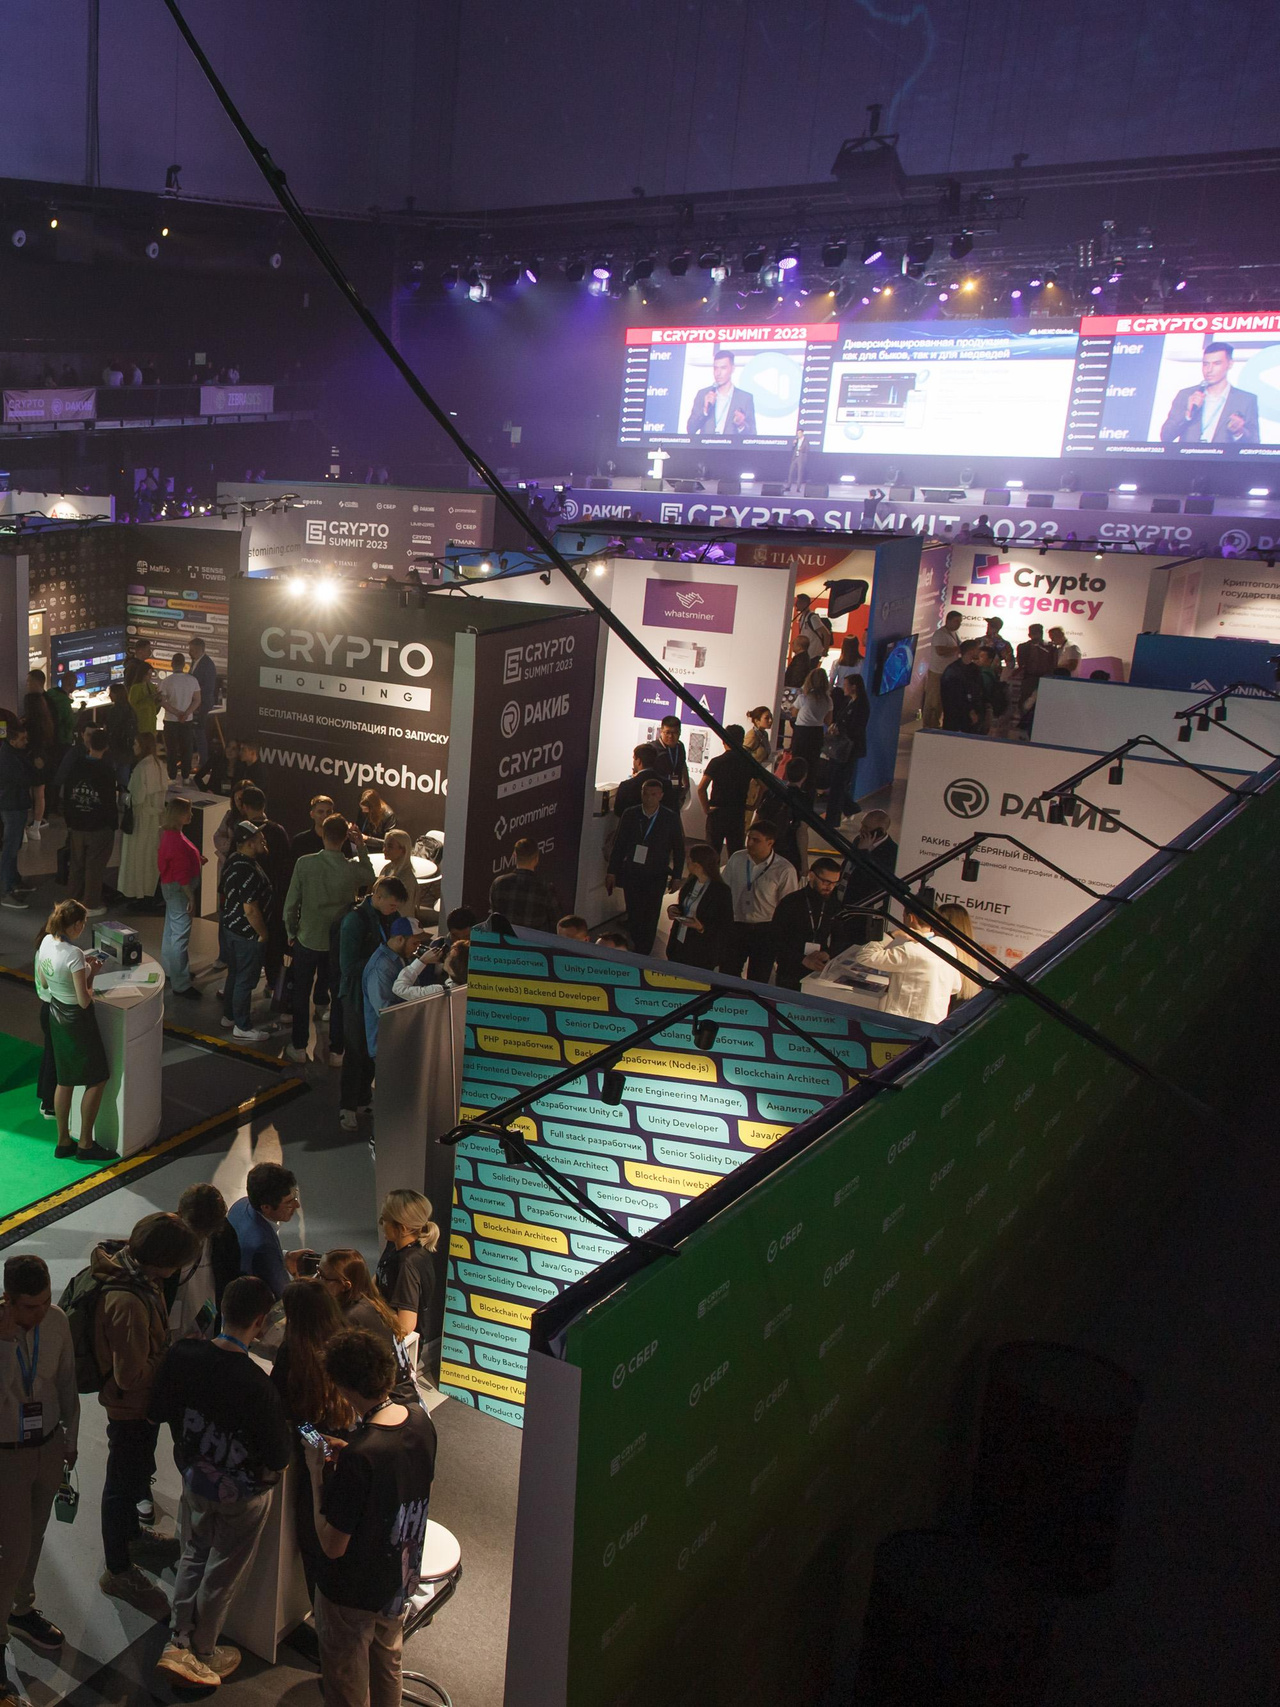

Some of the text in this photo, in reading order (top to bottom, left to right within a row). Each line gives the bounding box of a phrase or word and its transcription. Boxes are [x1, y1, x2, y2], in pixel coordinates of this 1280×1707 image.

[1133, 317, 1208, 332] CRYPTO
[664, 327, 807, 342] CRYPTO SUMMIT 2023
[328, 521, 390, 538] CRYPTO
[1099, 523, 1192, 541] CRYPTO
[328, 537, 388, 550] SUMMIT 2023
[771, 552, 826, 567] TIANLU
[201, 566, 224, 574] SENSE
[201, 573, 227, 581] TOWER
[1013, 568, 1106, 594] Crypto
[950, 585, 1104, 621] Emergency
[664, 608, 714, 621] whatsminer
[260, 627, 434, 677] CRYPTO
[525, 635, 575, 662] CRYPTO
[524, 658, 573, 680] SUMMIT 2023
[275, 675, 412, 702] HOLDING
[524, 694, 570, 726] РАКИБ
[259, 706, 449, 744] БЕСПЛАТНАЯ КОНСУЛЬТАЦИЯ ПО ЗАПУСКУ
[499, 740, 563, 778] CRYPTO
[503, 770, 556, 793] HOLDING
[509, 803, 557, 833] promminer
[921, 836, 951, 848] РАКИБ
[1008, 865, 1053, 879] полиграфии
[935, 891, 1011, 916] NFT-БИЛЕТ
[473, 954, 544, 969] stack разработчик
[564, 964, 630, 978] Unity Developer
[495, 983, 601, 1003] (web3) Backend Developer
[634, 997, 659, 1008] Smart
[490, 1010, 530, 1023] Developer
[787, 1011, 836, 1025] Аналитик
[565, 1019, 626, 1034] Senior DevOps
[483, 1034, 554, 1051] PHP разработчик
[659, 1029, 691, 1043] Golang
[788, 1042, 812, 1054] Data
[477, 1063, 551, 1081] Frontend Developer
[669, 1059, 709, 1073] (Node.js)
[734, 1066, 830, 1087] Blockchain Architect
[461, 1088, 489, 1100] Product
[645, 1088, 742, 1108] Engineering Manager,
[536, 1100, 623, 1119] Разработчик Unity C#
[766, 1102, 814, 1116] Аналитик
[648, 1115, 719, 1134] Unity Developer
[550, 1129, 642, 1152] Full stack разработчик
[660, 1146, 723, 1166] Senior Solidity
[573, 1159, 609, 1173] Architect
[492, 1172, 520, 1186] Solidity
[635, 1171, 681, 1185] Blockchain
[470, 1194, 506, 1207] Аналитик
[596, 1191, 658, 1210] Senior DevOps
[526, 1205, 578, 1222] Разработчик
[483, 1222, 558, 1243] Blockchain Architect
[779, 1222, 803, 1250] СБЕР
[482, 1248, 518, 1263] Аналитик
[577, 1241, 596, 1253] Lead
[541, 1260, 573, 1274] Java/Go
[463, 1268, 556, 1297] Senior Solidity Developer
[479, 1303, 518, 1319] Blockchain
[452, 1320, 517, 1343] Solidity Developer
[482, 1353, 500, 1367] Ruby
[628, 1340, 658, 1373] СБЕР
[471, 1373, 509, 1391] Developer
[702, 1361, 730, 1392] СБЕР
[485, 1404, 514, 1419] Product
